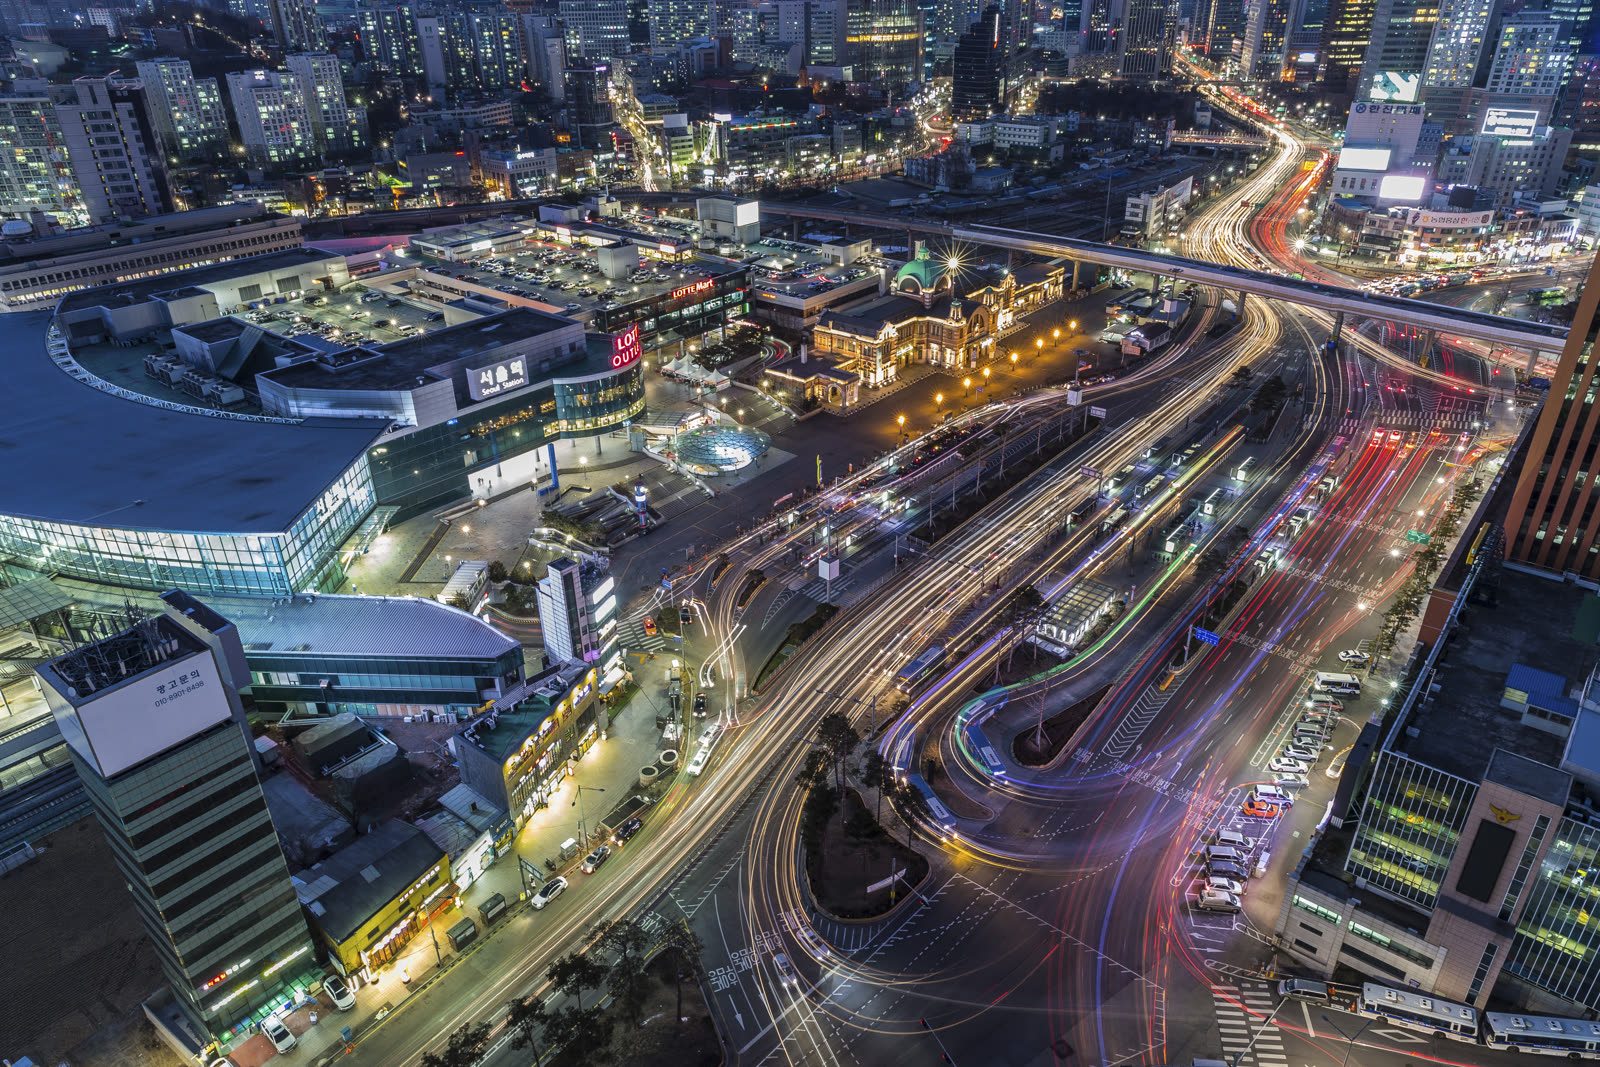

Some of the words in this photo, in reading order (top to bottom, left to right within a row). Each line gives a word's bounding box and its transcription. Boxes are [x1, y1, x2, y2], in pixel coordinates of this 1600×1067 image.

[1369, 104, 1421, 115] 한진택배
[673, 286, 696, 298] LOTTE
[695, 279, 714, 291] Mart
[480, 360, 524, 385] 서울역
[481, 384, 500, 396] Seoul
[502, 377, 524, 389] Station
[156, 669, 200, 694] 광고문의
[154, 680, 205, 707] 010-8901-8498
